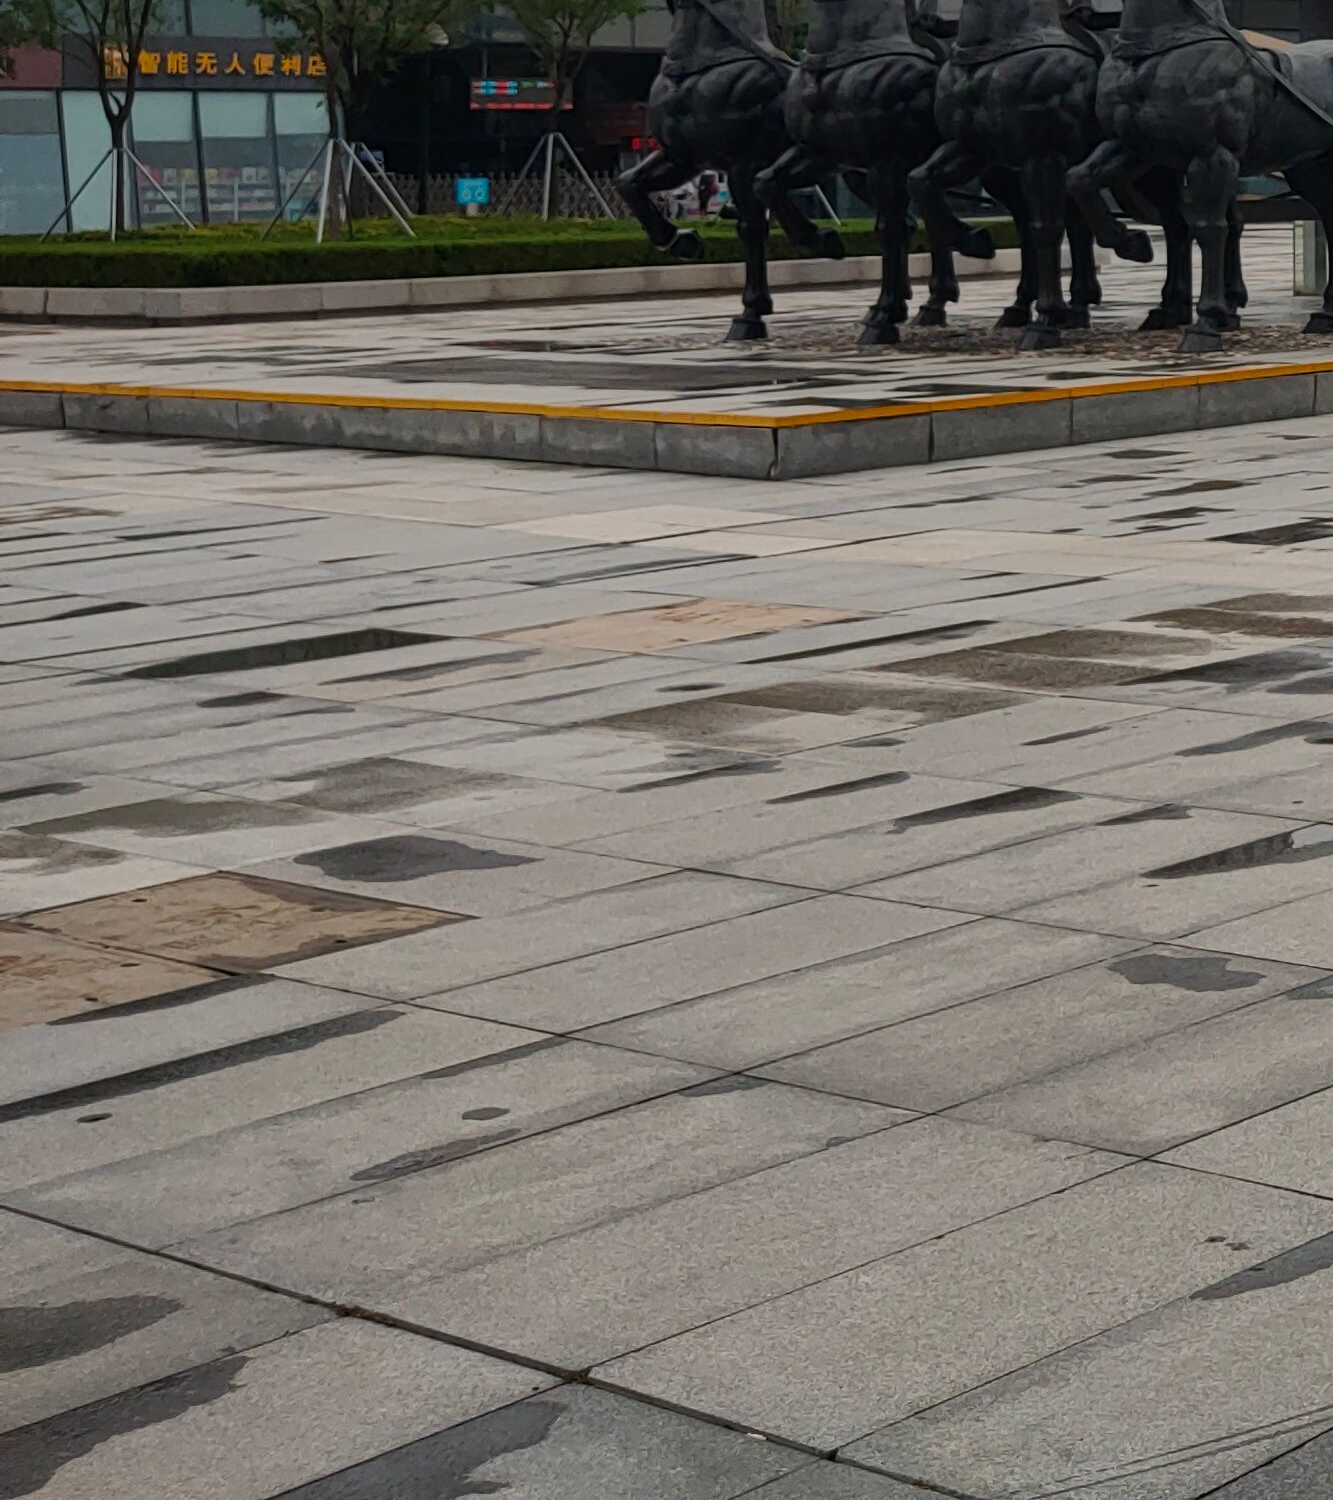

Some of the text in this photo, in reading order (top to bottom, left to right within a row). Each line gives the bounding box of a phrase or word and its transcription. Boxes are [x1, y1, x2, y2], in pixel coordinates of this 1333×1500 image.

[137, 49, 328, 77] 智能无人便利店
